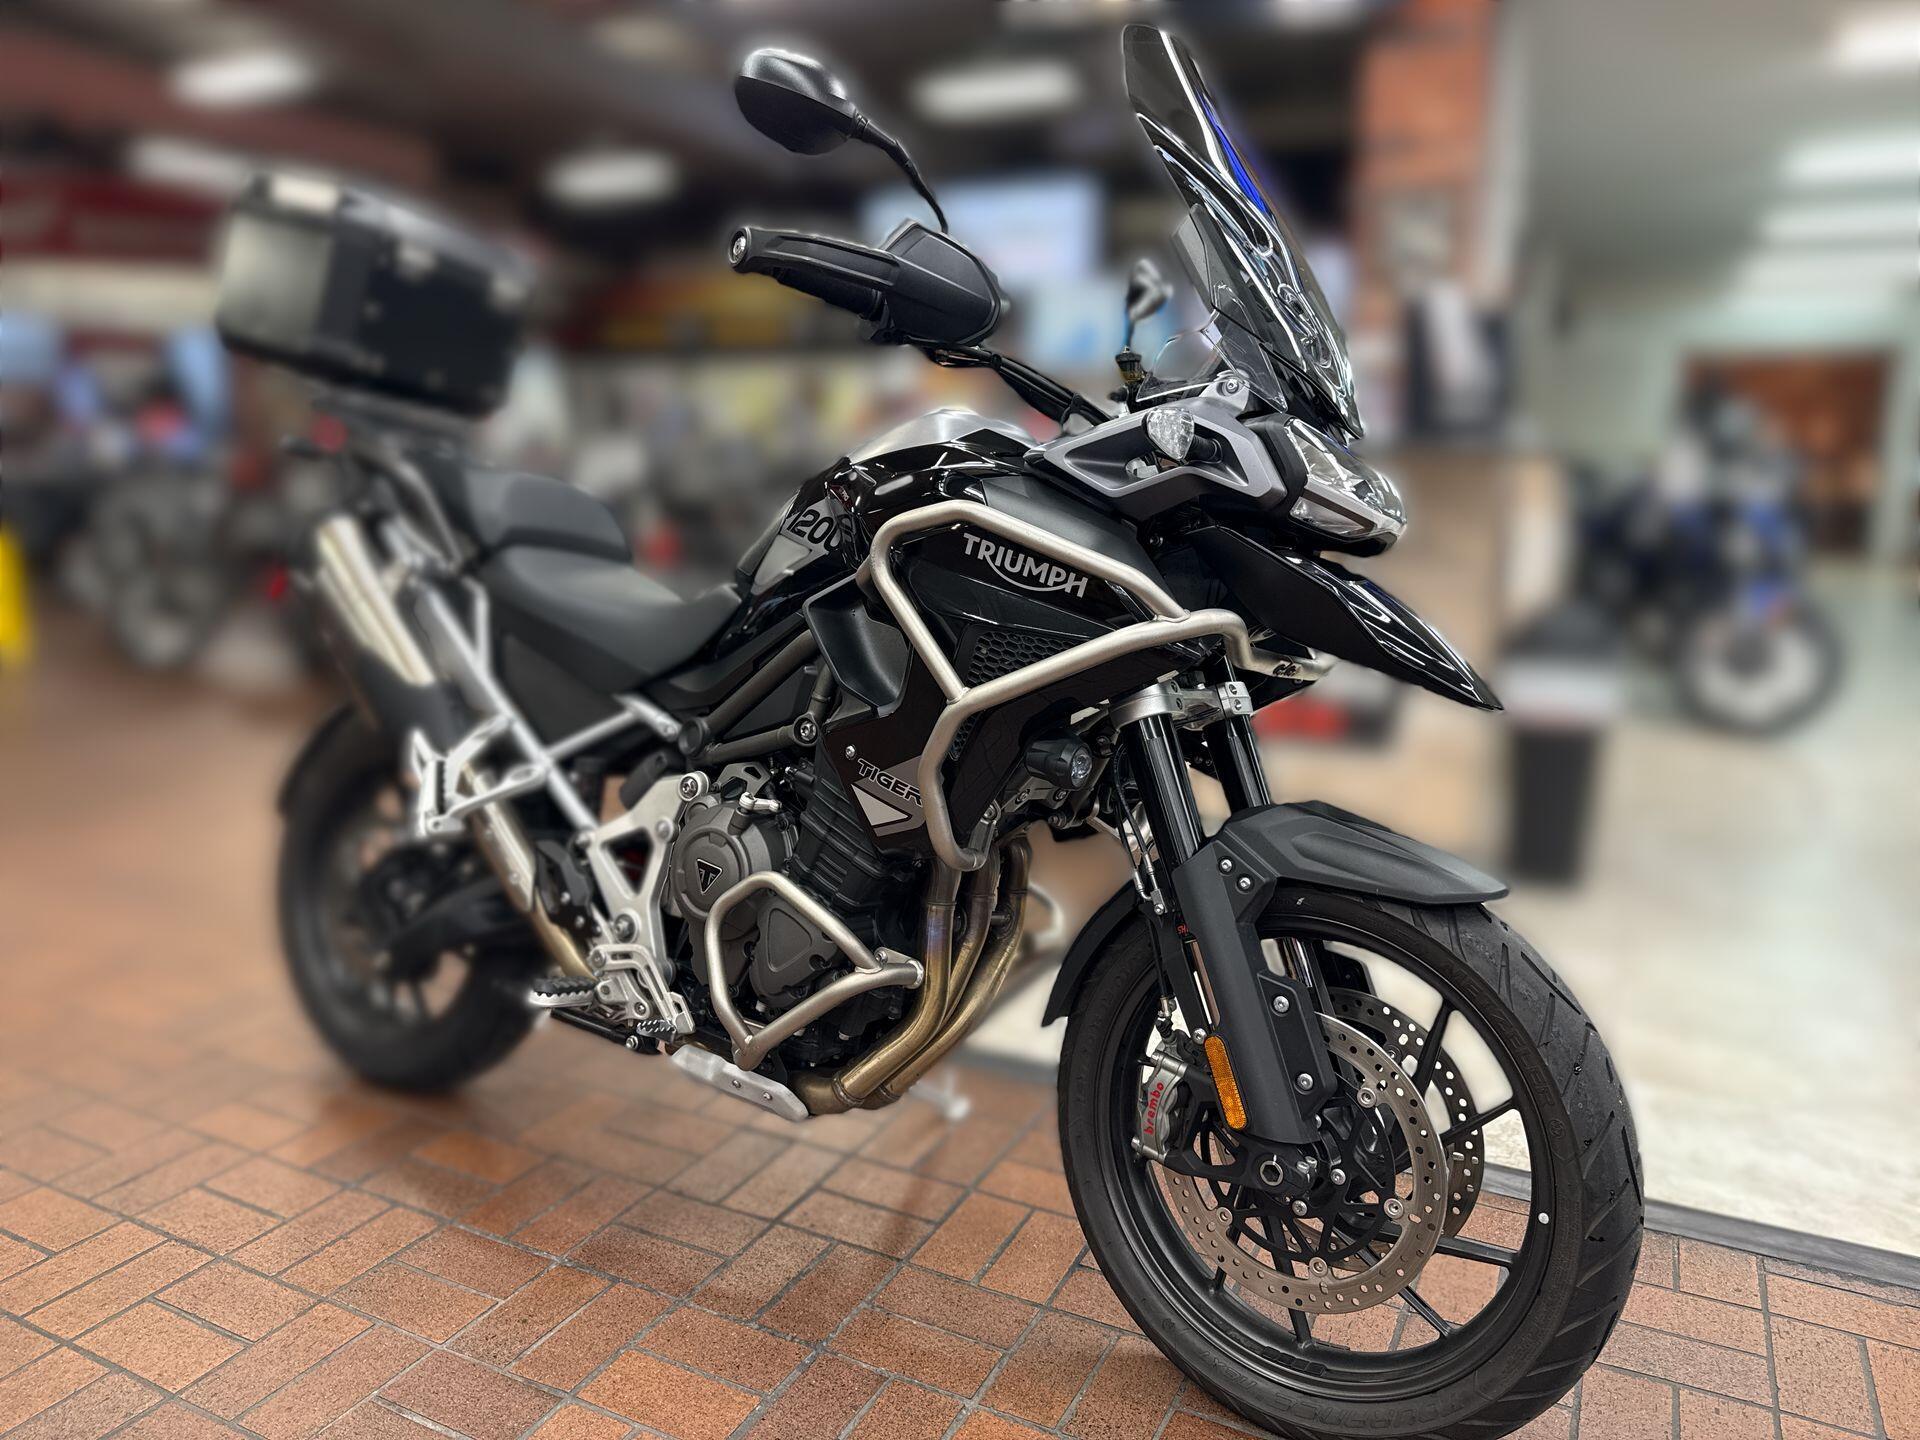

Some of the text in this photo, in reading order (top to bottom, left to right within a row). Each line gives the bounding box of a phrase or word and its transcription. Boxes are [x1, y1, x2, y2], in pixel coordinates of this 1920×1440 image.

[963, 532, 1089, 599] TRIUMPH
[857, 757, 924, 808] TIGER
[1143, 1081, 1165, 1137] brembo
